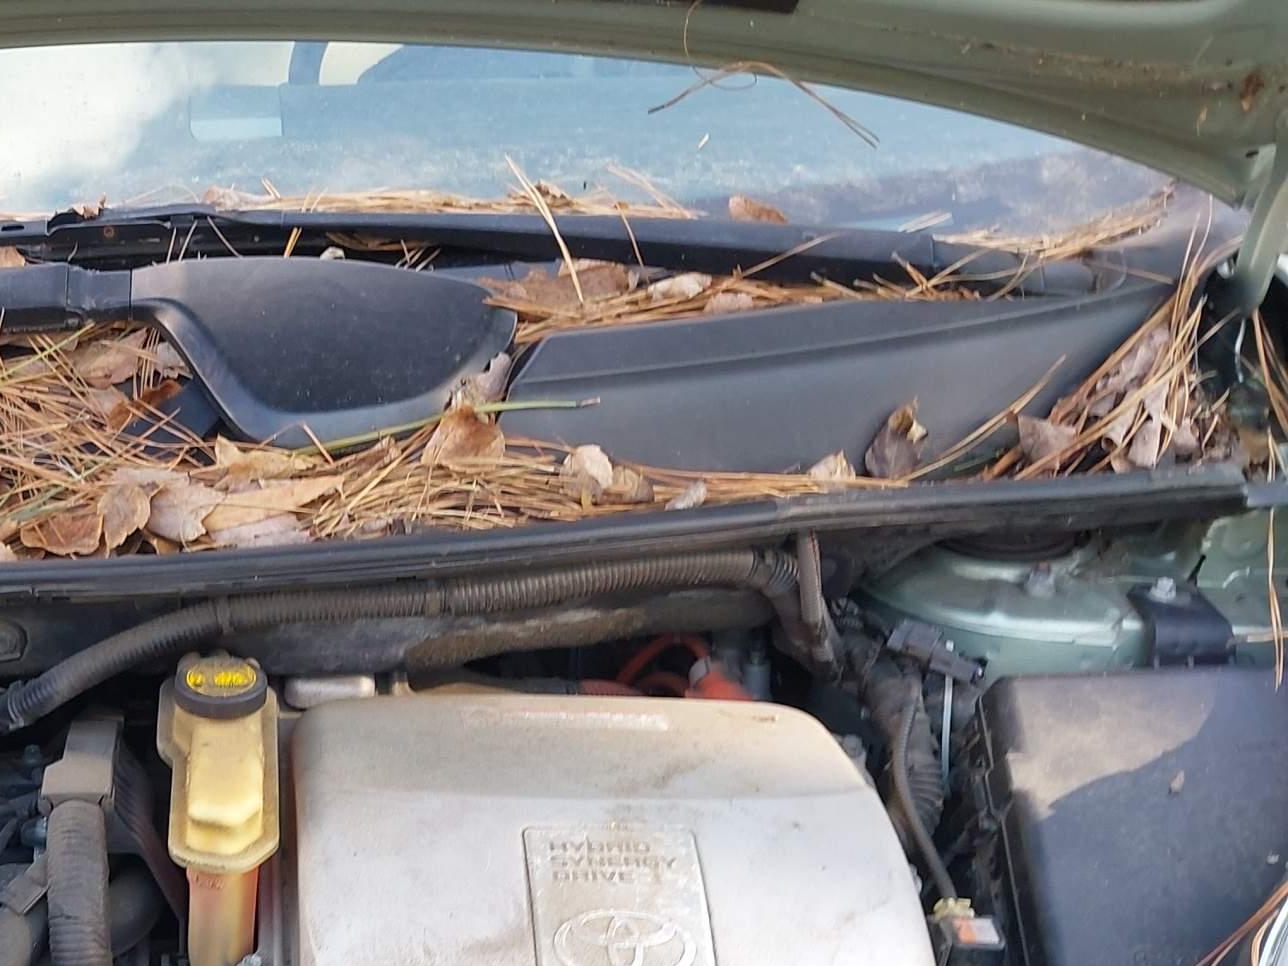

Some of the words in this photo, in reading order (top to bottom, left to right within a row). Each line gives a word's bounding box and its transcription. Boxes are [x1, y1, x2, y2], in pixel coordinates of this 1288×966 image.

[549, 841, 651, 853] HYBRID
[550, 855, 677, 868] SYNERGY
[552, 870, 634, 882] DRIVE
